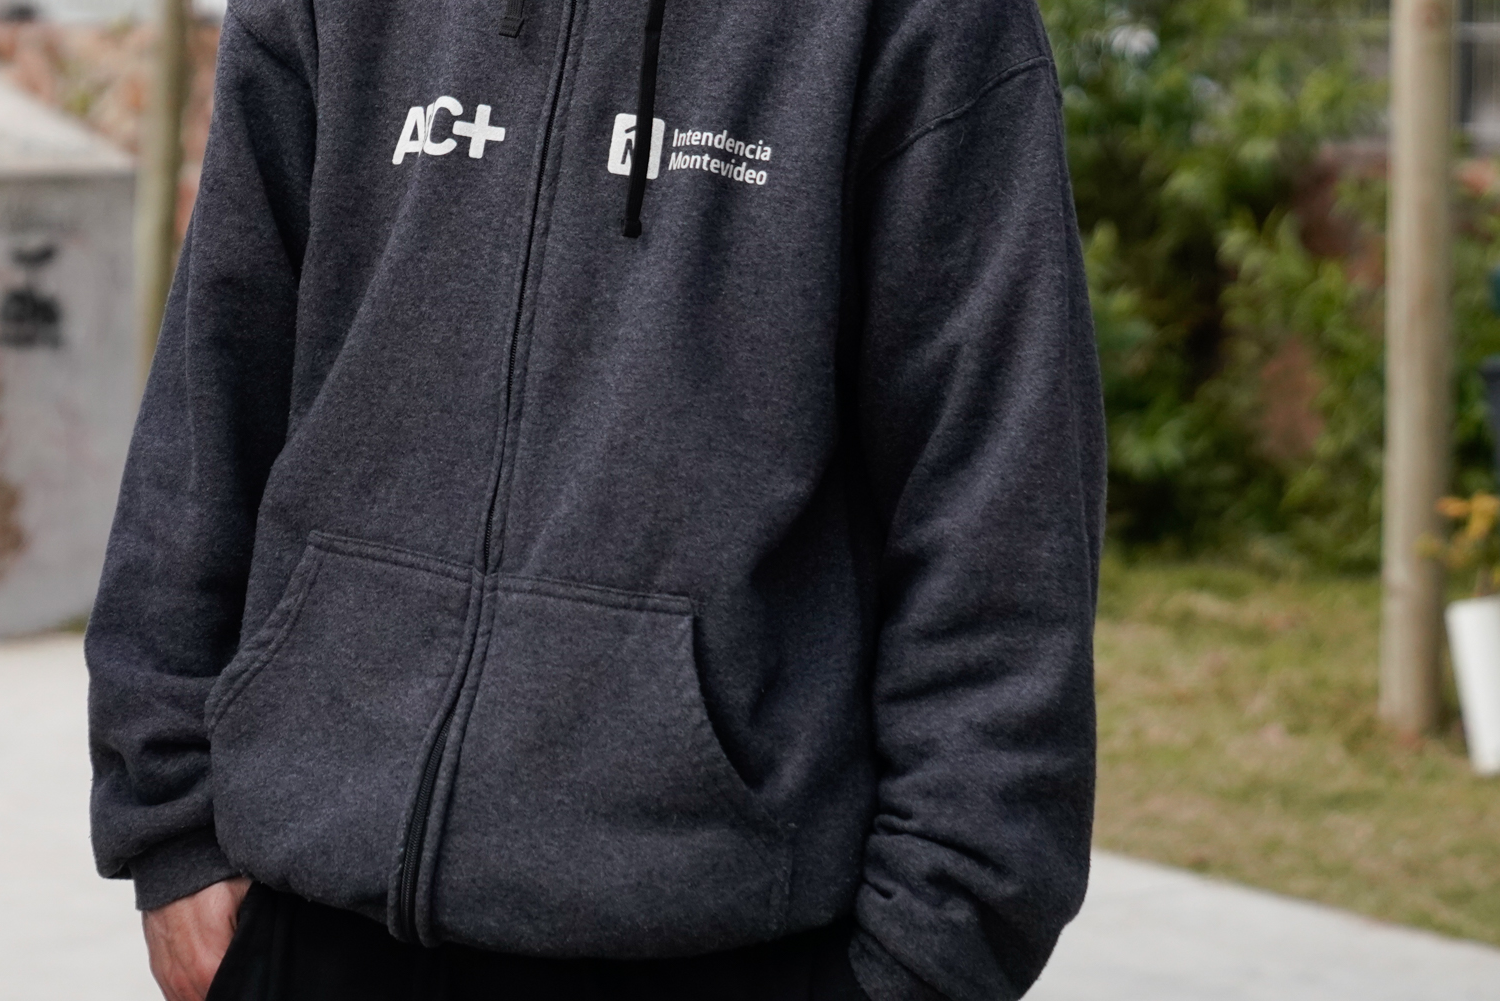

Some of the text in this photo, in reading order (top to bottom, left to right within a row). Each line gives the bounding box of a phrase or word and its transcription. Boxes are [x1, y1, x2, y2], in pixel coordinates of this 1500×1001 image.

[392, 95, 506, 165] AC+
[672, 128, 773, 162] Intendencia
[668, 151, 768, 186] Montevideo
